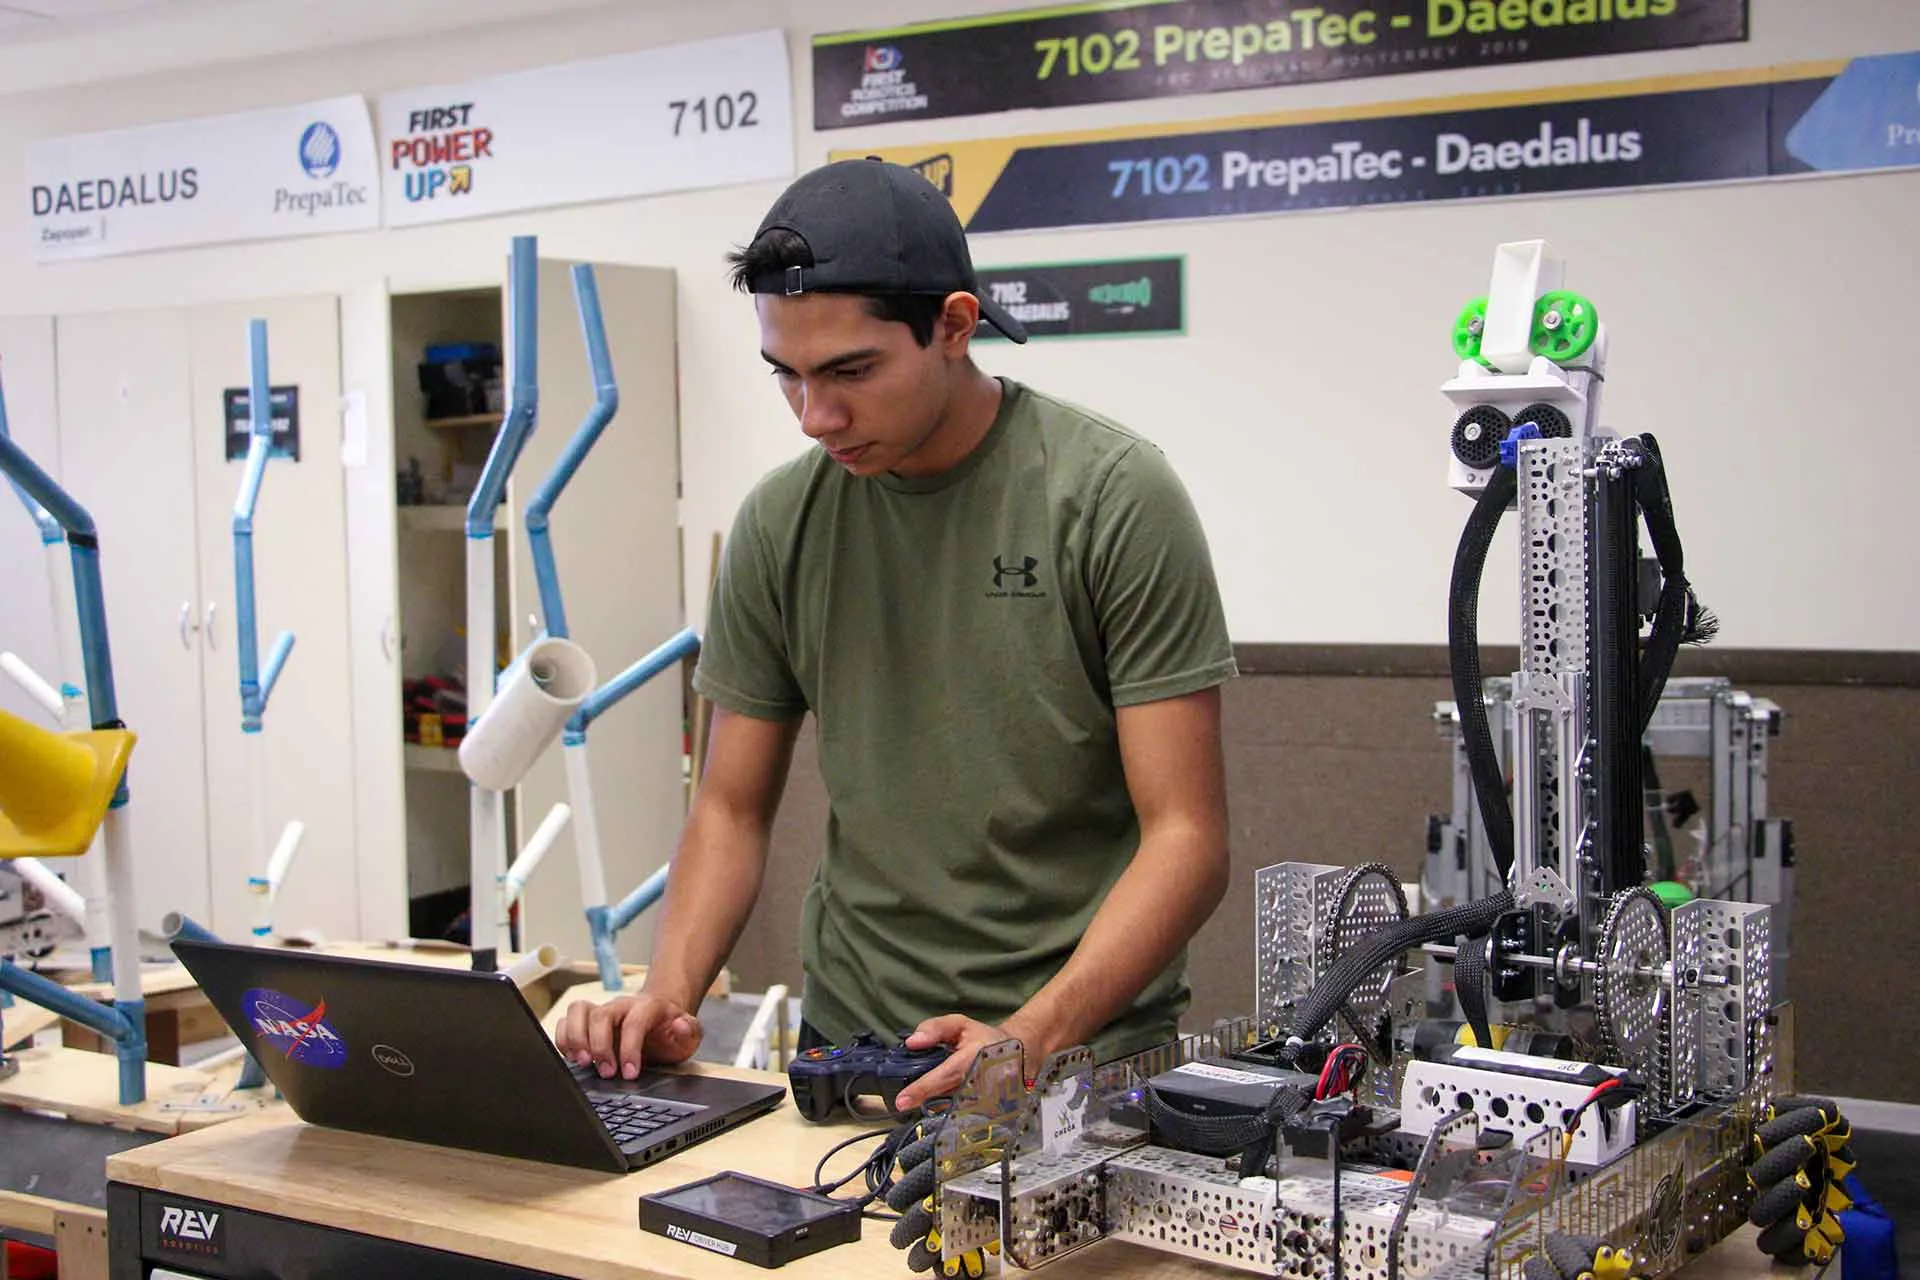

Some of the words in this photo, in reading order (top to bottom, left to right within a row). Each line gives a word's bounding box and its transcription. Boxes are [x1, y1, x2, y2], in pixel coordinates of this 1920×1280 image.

[1035, 29, 1141, 80] 7102
[1154, 8, 1377, 66] PrepaTec
[409, 103, 474, 133] FIRST
[669, 90, 759, 136] 7102
[392, 127, 493, 170] POWER
[1108, 154, 1210, 198] 7102
[1222, 141, 1403, 196] PrepaTec
[1436, 118, 1643, 175] Daedalus
[32, 167, 198, 216] DAEDALUS
[272, 181, 367, 217] PrepaTec
[405, 169, 446, 202] UP
[255, 1017, 339, 1041] NASA
[160, 1206, 219, 1240] REV
[667, 1223, 691, 1241] REV
